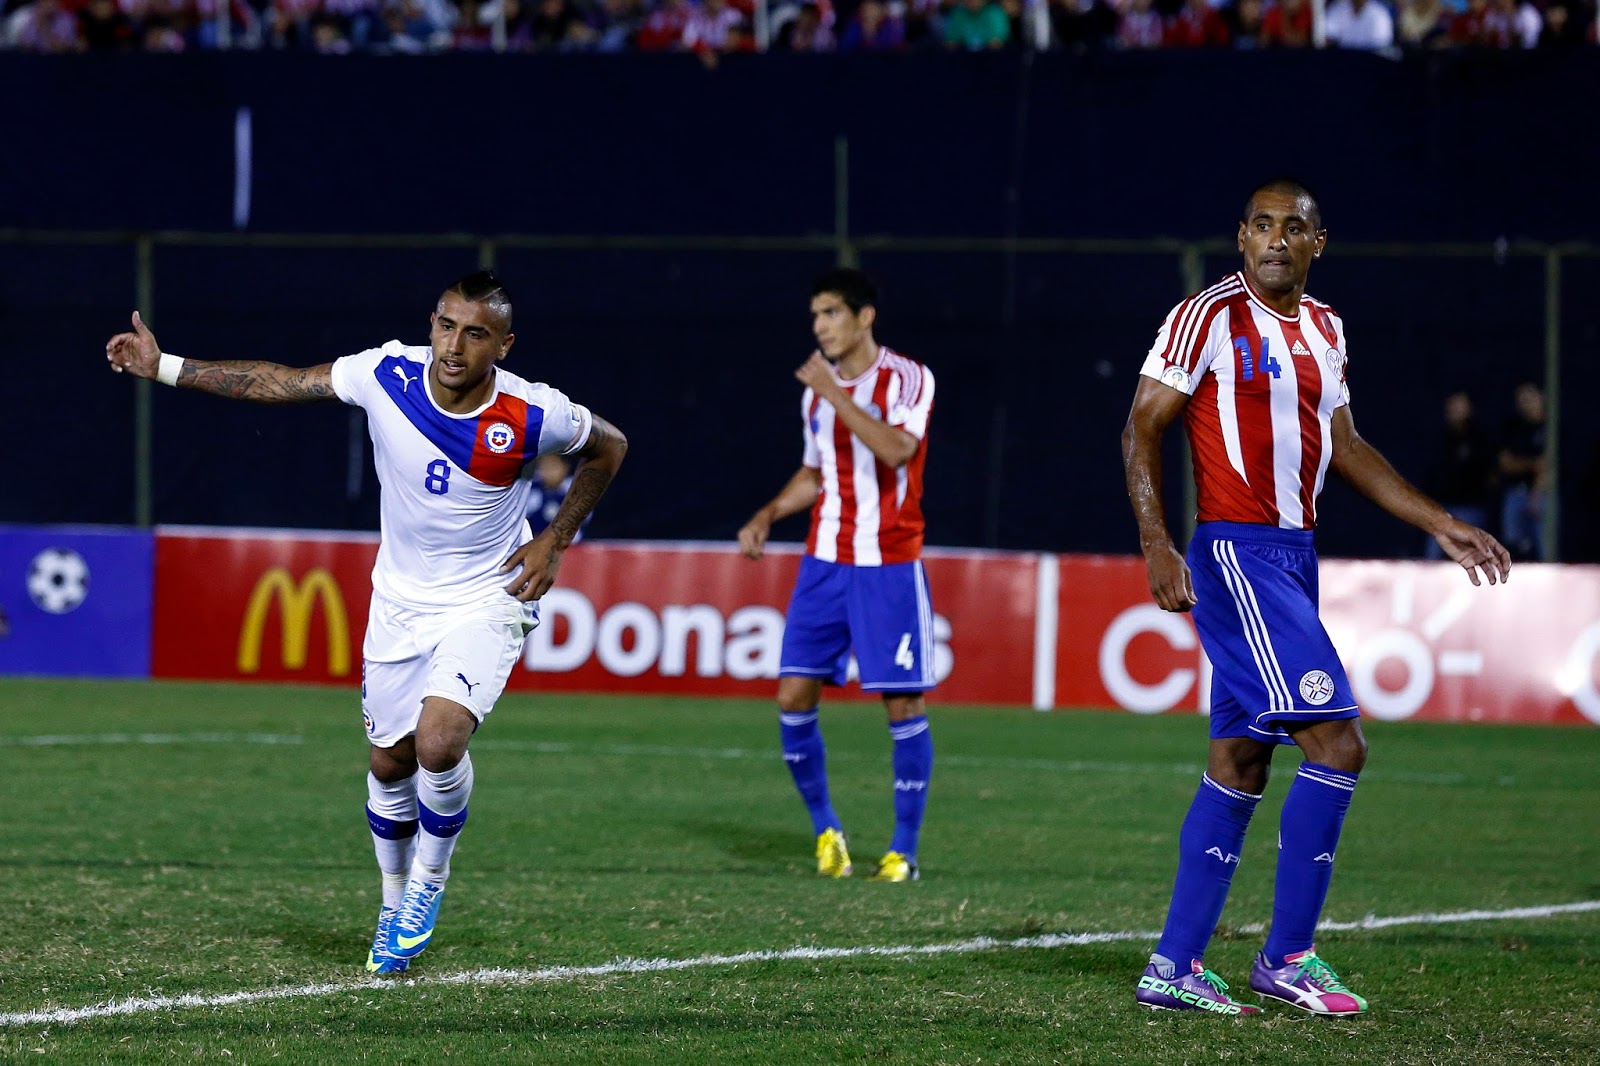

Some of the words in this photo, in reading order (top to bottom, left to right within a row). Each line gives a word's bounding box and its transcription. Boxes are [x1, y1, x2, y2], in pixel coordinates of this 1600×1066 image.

[1234, 335, 1282, 379] 14
[425, 458, 451, 496] 8
[894, 632, 915, 671] 4
